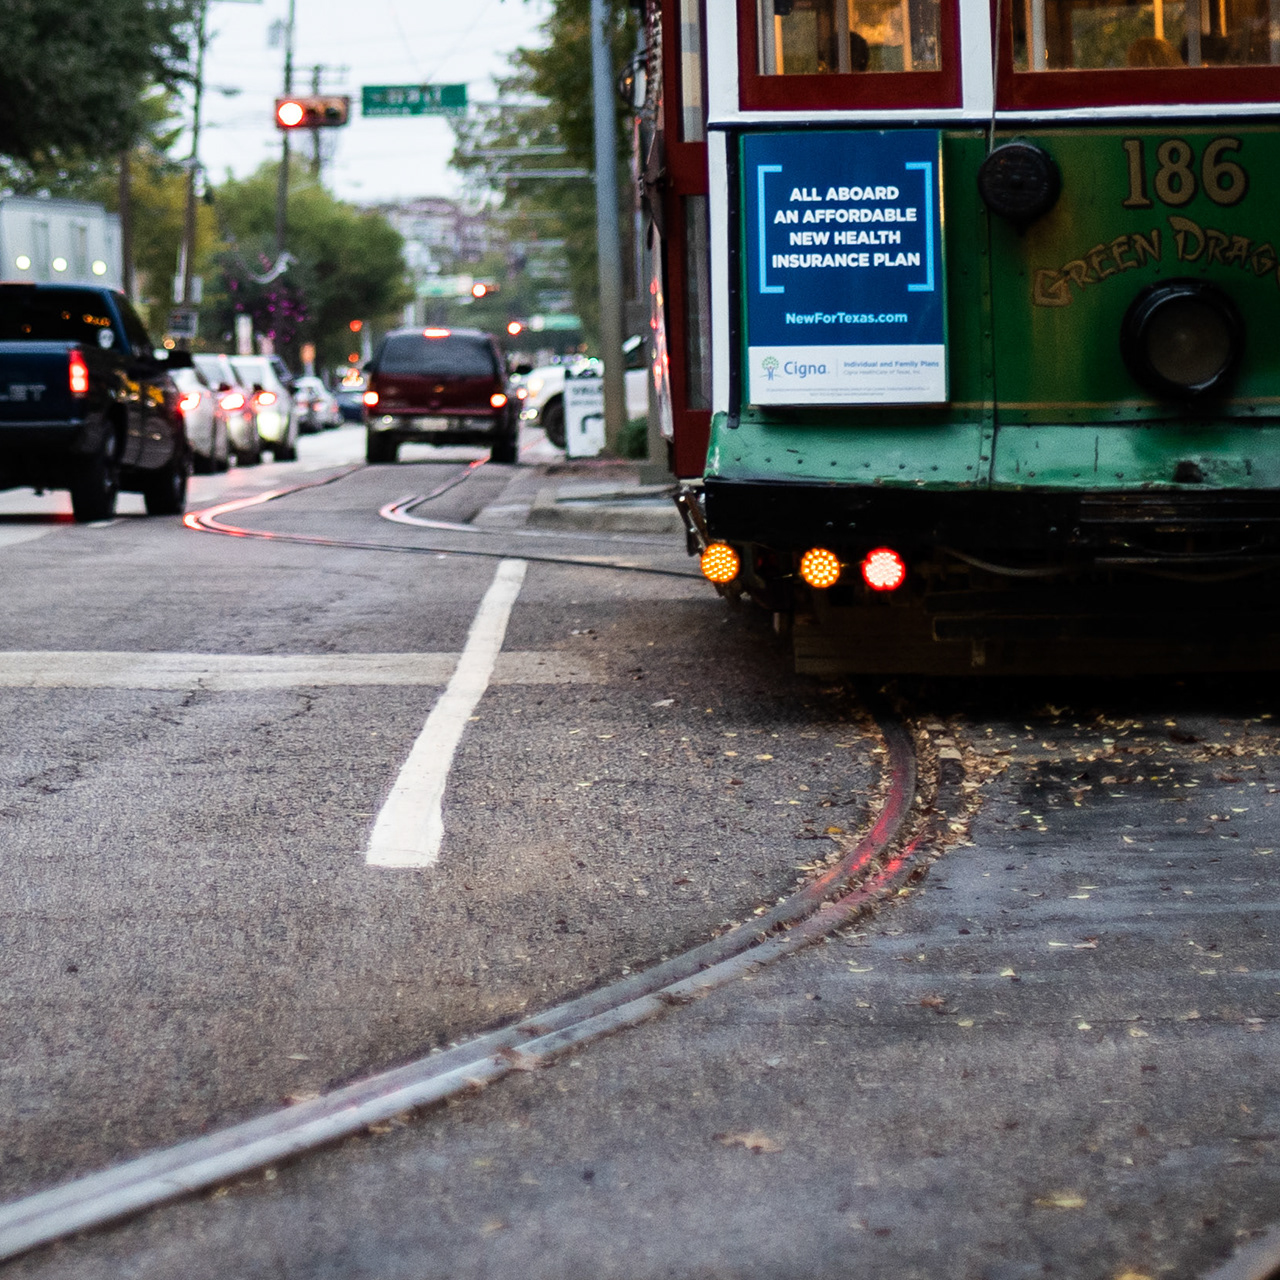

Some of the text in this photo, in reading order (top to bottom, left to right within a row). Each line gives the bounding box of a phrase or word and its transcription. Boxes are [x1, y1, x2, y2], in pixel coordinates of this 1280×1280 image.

[1123, 136, 1248, 209] 186
[789, 186, 900, 202] ALL ABOARD
[773, 208, 917, 224] AN AFFORDABLE
[789, 230, 901, 246] NEW HEALTH
[772, 252, 921, 268] INSURANCE PLAN
[1033, 228, 1162, 307] GREEN
[785, 311, 908, 325] NewForTexas.com
[783, 361, 827, 379] Cigna
[843, 360, 878, 368] Individual
[879, 360, 893, 368] and
